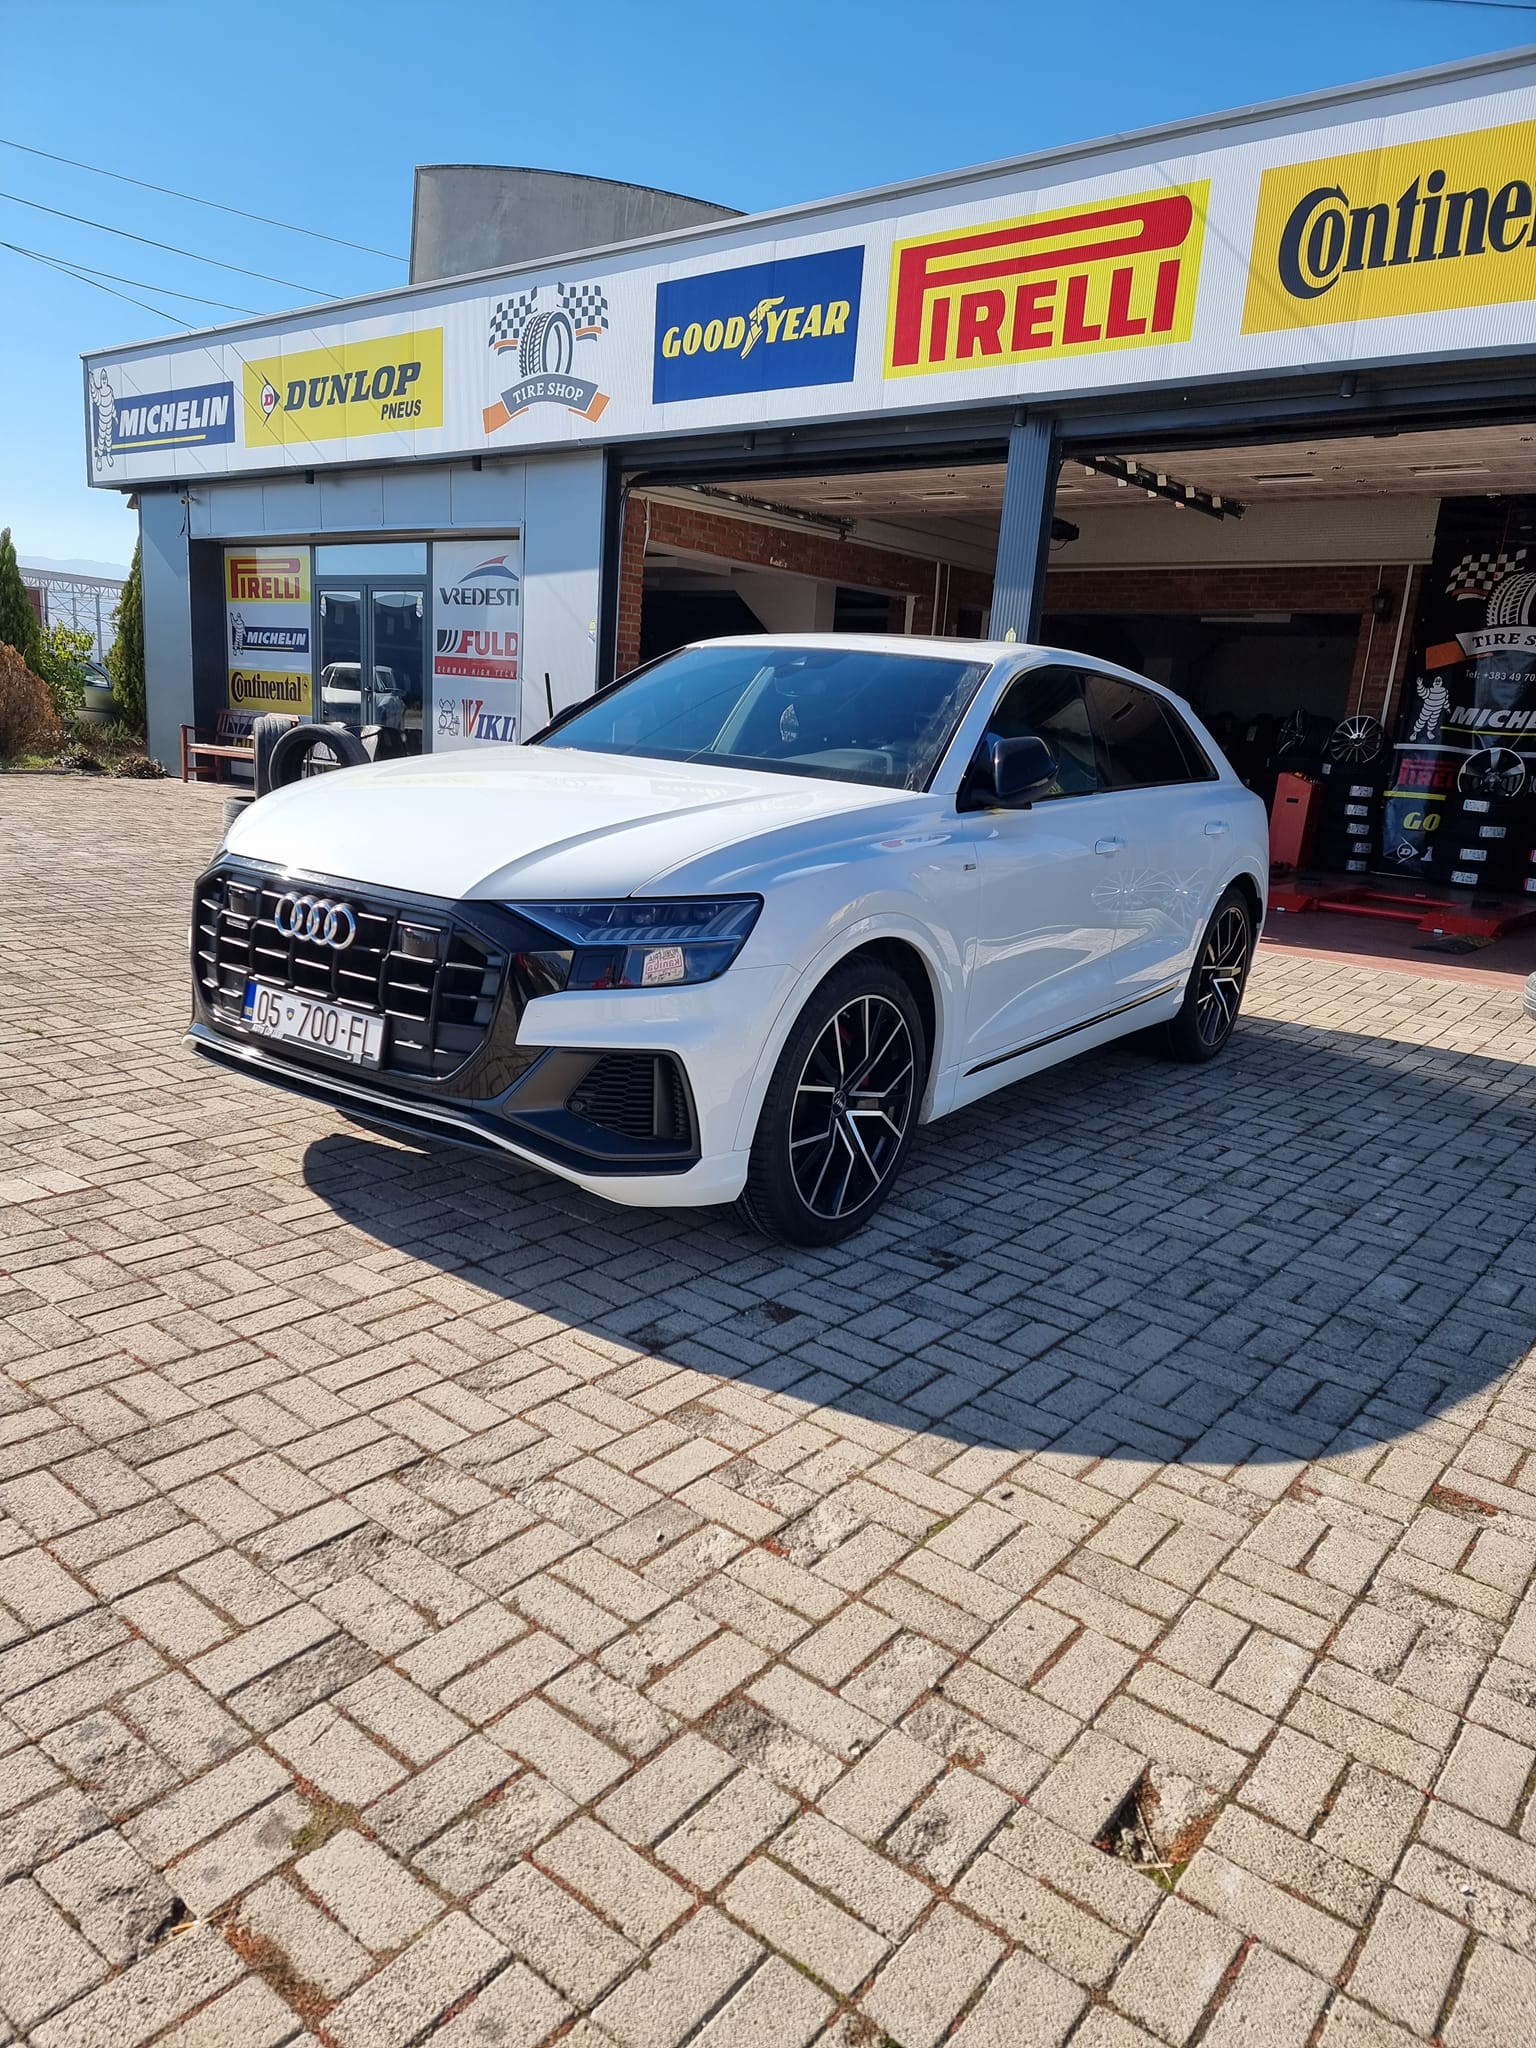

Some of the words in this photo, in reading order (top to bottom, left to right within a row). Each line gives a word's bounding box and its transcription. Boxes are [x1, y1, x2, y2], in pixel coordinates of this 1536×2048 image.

[1278, 169, 1536, 299] Contine
[892, 195, 1192, 367] PIRELLI
[284, 362, 421, 412] DUNLOP
[513, 383, 544, 404] TIRE
[547, 382, 583, 401] SHOP
[119, 396, 229, 438] MICHELIN
[381, 400, 421, 420] PNEUS
[230, 559, 301, 599] PIRELLI
[247, 631, 306, 646] MICHELIN
[1472, 633, 1521, 648] TIRE
[231, 671, 302, 702] Continental
[1465, 669, 1480, 679] Tel:
[1483, 671, 1507, 681] +383
[1509, 672, 1521, 681] 49
[1524, 673, 1536, 682] 70
[256, 990, 283, 1027] 05
[297, 1002, 374, 1058] 700-FL
